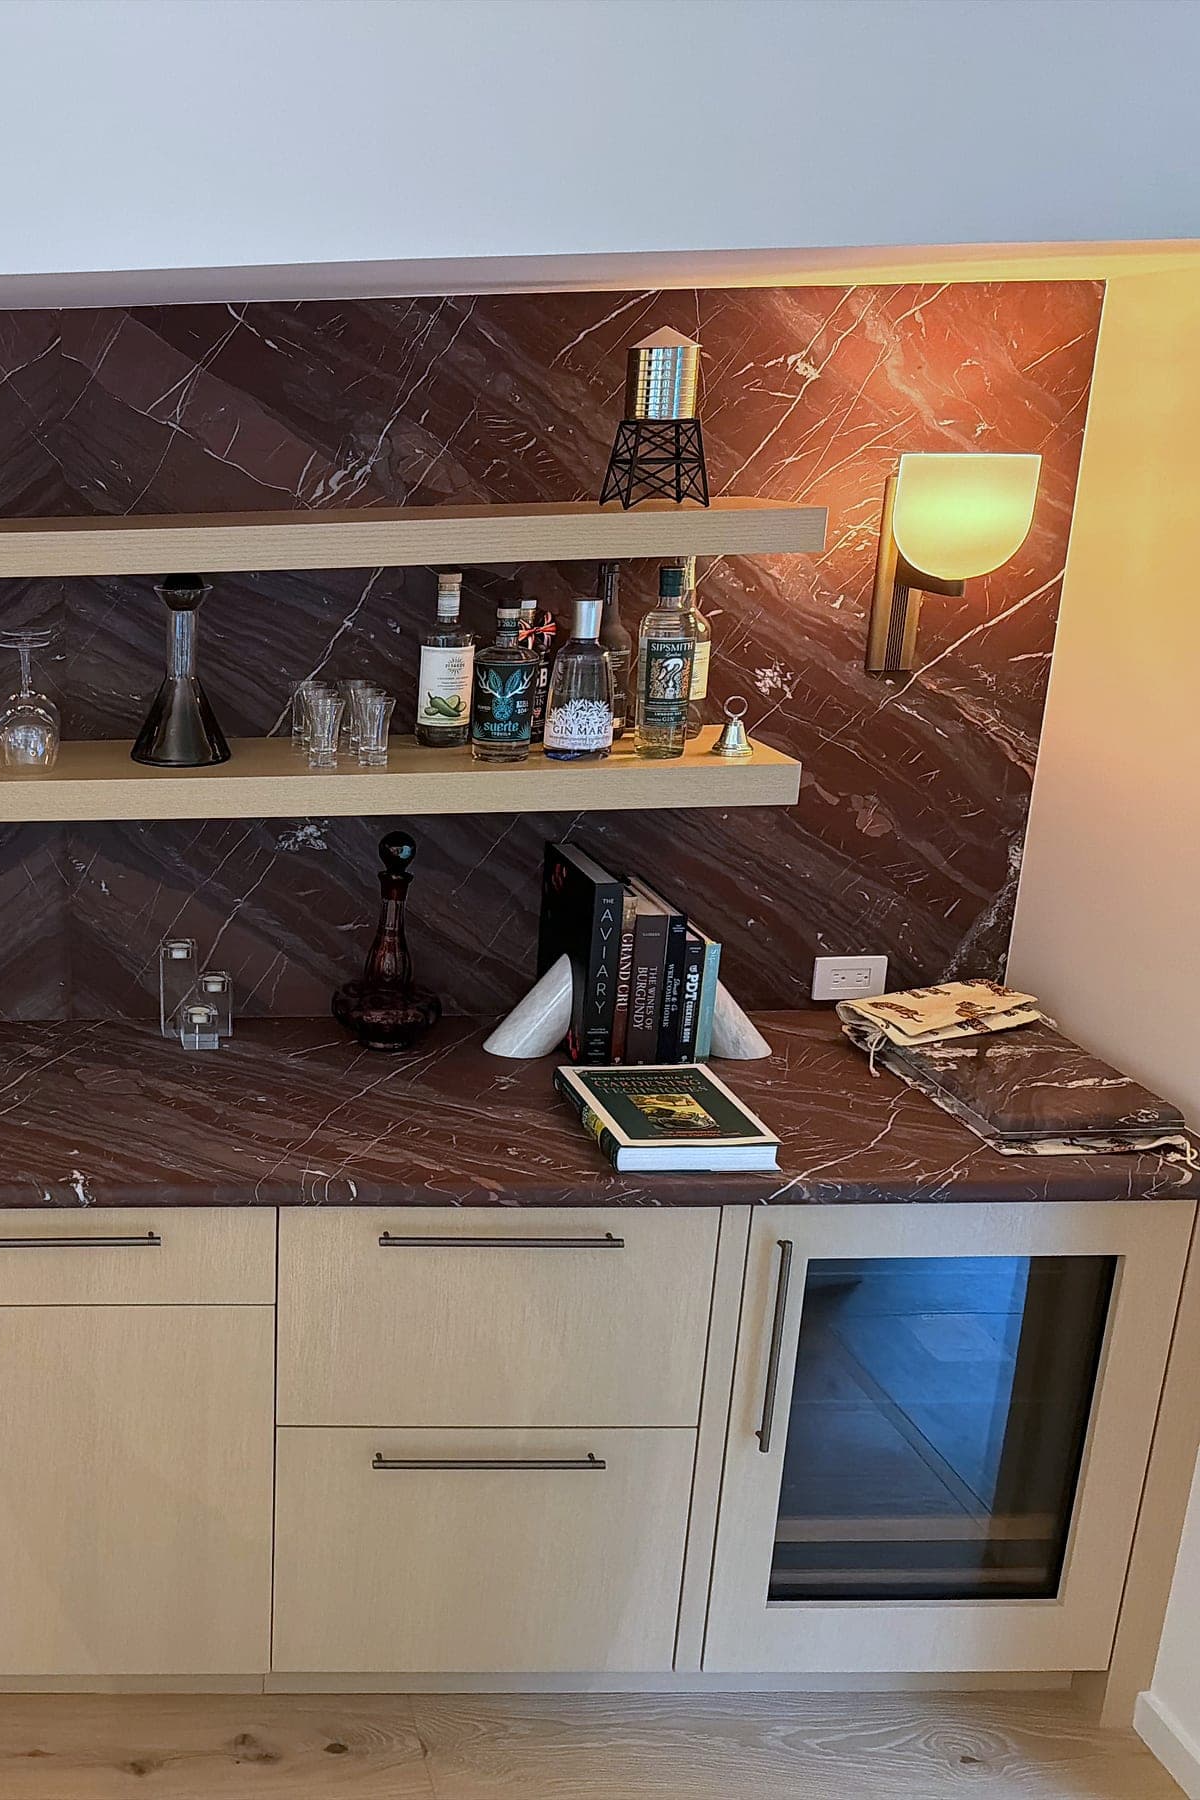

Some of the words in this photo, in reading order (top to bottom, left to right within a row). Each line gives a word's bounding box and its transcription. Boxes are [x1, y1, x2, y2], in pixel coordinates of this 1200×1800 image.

[651, 642, 693, 652] SIPSMITH
[553, 725, 573, 734] GIN
[578, 725, 609, 736] MARE
[595, 908, 614, 1014] AVIARY
[619, 933, 634, 981] GRAND
[648, 966, 658, 985] THE
[665, 963, 675, 1003] WELCOME
[685, 973, 700, 1001] PDT
[615, 984, 629, 1012] CRU
[633, 966, 648, 1030] BURGUNDY
[646, 986, 657, 1016] WINES
[644, 1018, 654, 1031] OF
[662, 1004, 671, 1028] HOME
[593, 1079, 702, 1088] GARDENING
